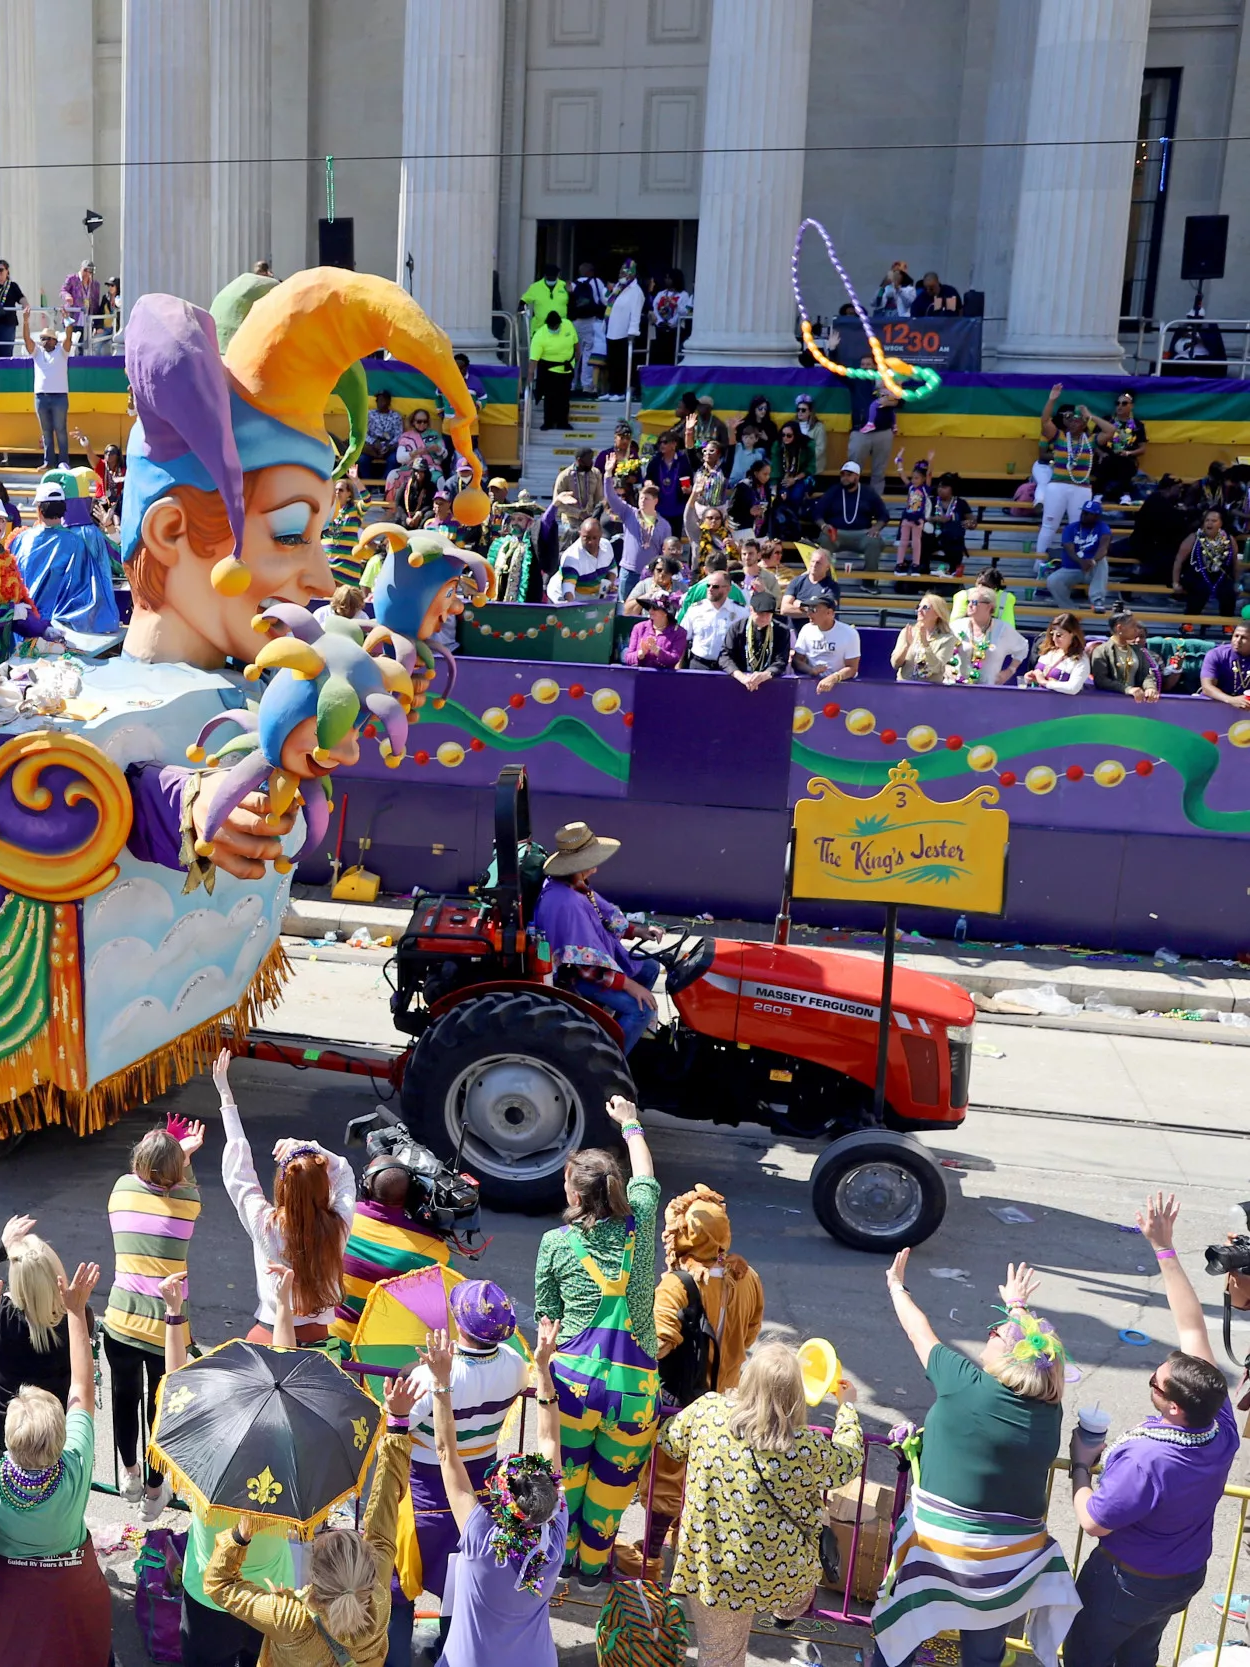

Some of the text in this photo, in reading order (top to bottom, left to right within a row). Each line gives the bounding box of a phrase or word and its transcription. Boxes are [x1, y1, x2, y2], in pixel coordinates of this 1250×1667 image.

[895, 791, 907, 808] 3
[814, 833, 965, 876] The King's Jester
[753, 1002, 792, 1016] 2605
[755, 987, 874, 1018] MASSEY FERGUSON
[7, 1559, 28, 1567] Guided
[64, 1559, 83, 1567] Rallies
